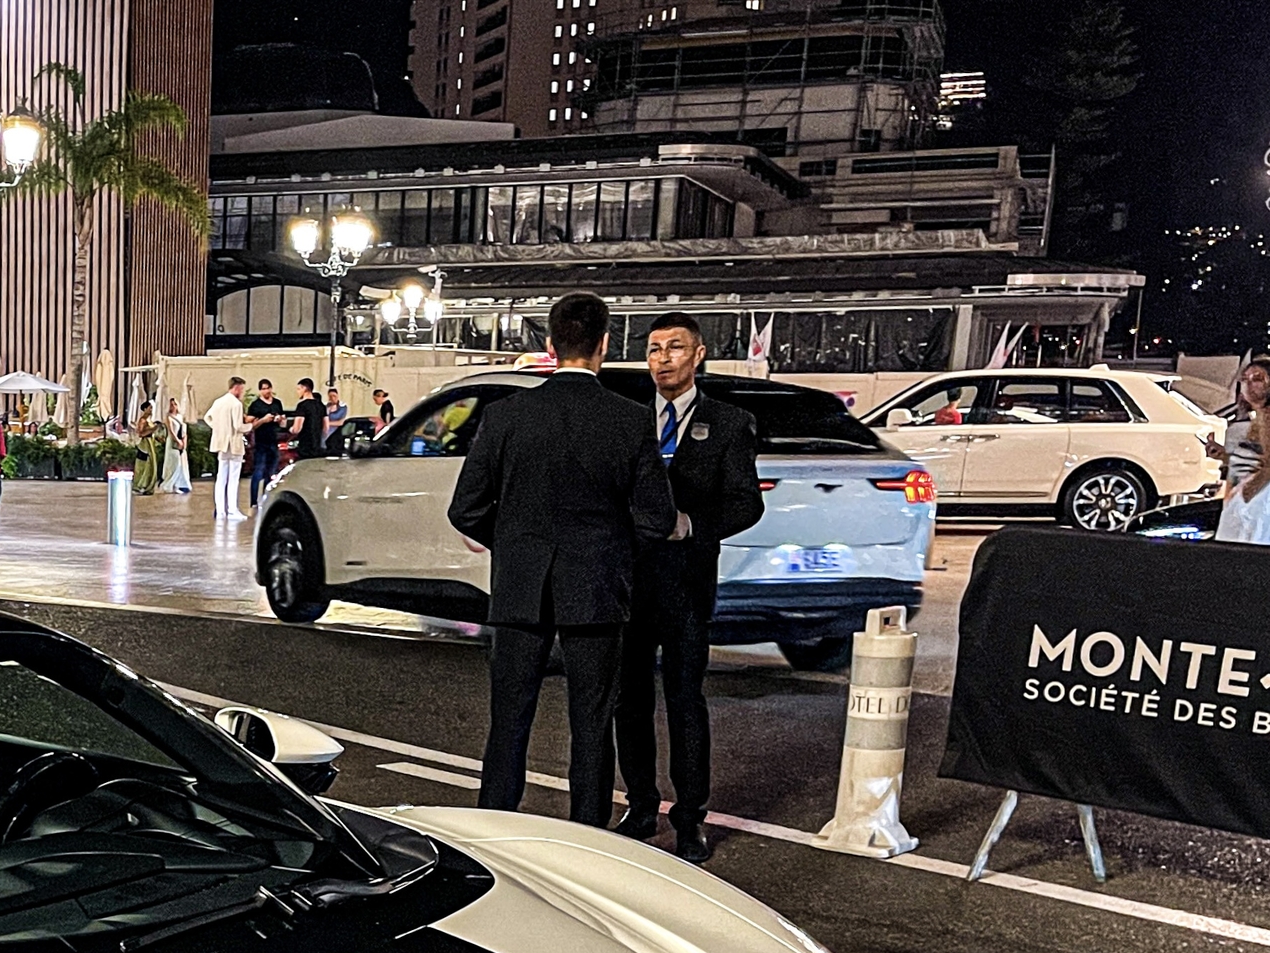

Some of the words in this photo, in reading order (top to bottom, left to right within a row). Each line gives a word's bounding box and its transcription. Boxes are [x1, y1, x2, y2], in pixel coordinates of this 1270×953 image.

[1028, 624, 1257, 697] MONTE
[1023, 678, 1161, 717] SOCIÉTÉ
[1173, 698, 1238, 729] DES
